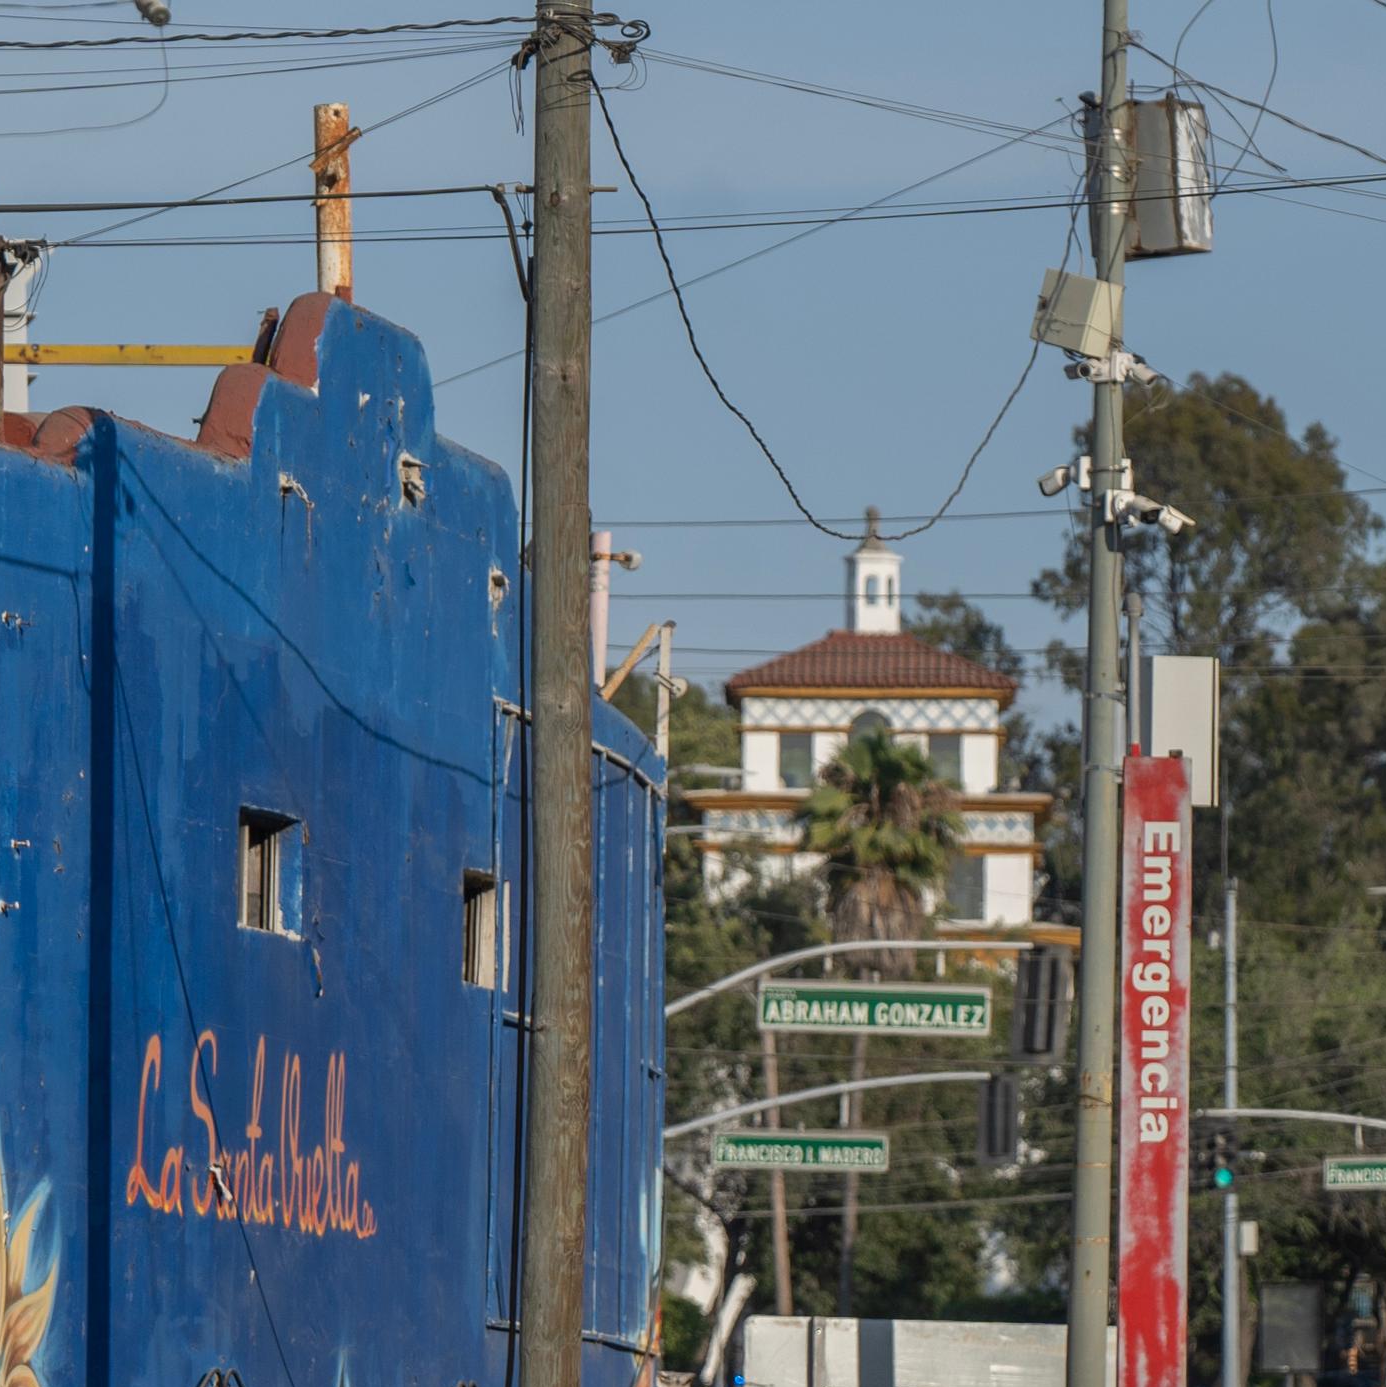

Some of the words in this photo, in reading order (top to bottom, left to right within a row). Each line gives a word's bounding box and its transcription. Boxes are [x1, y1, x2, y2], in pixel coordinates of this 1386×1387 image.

[764, 999, 869, 1025] ABRAHAM
[874, 1001, 987, 1029] GONZALEZ
[1132, 819, 1181, 1145] Emergencia
[126, 1034, 184, 1218] La
[717, 1142, 803, 1163] FRANCISCO
[818, 1146, 885, 1165] MADERO
